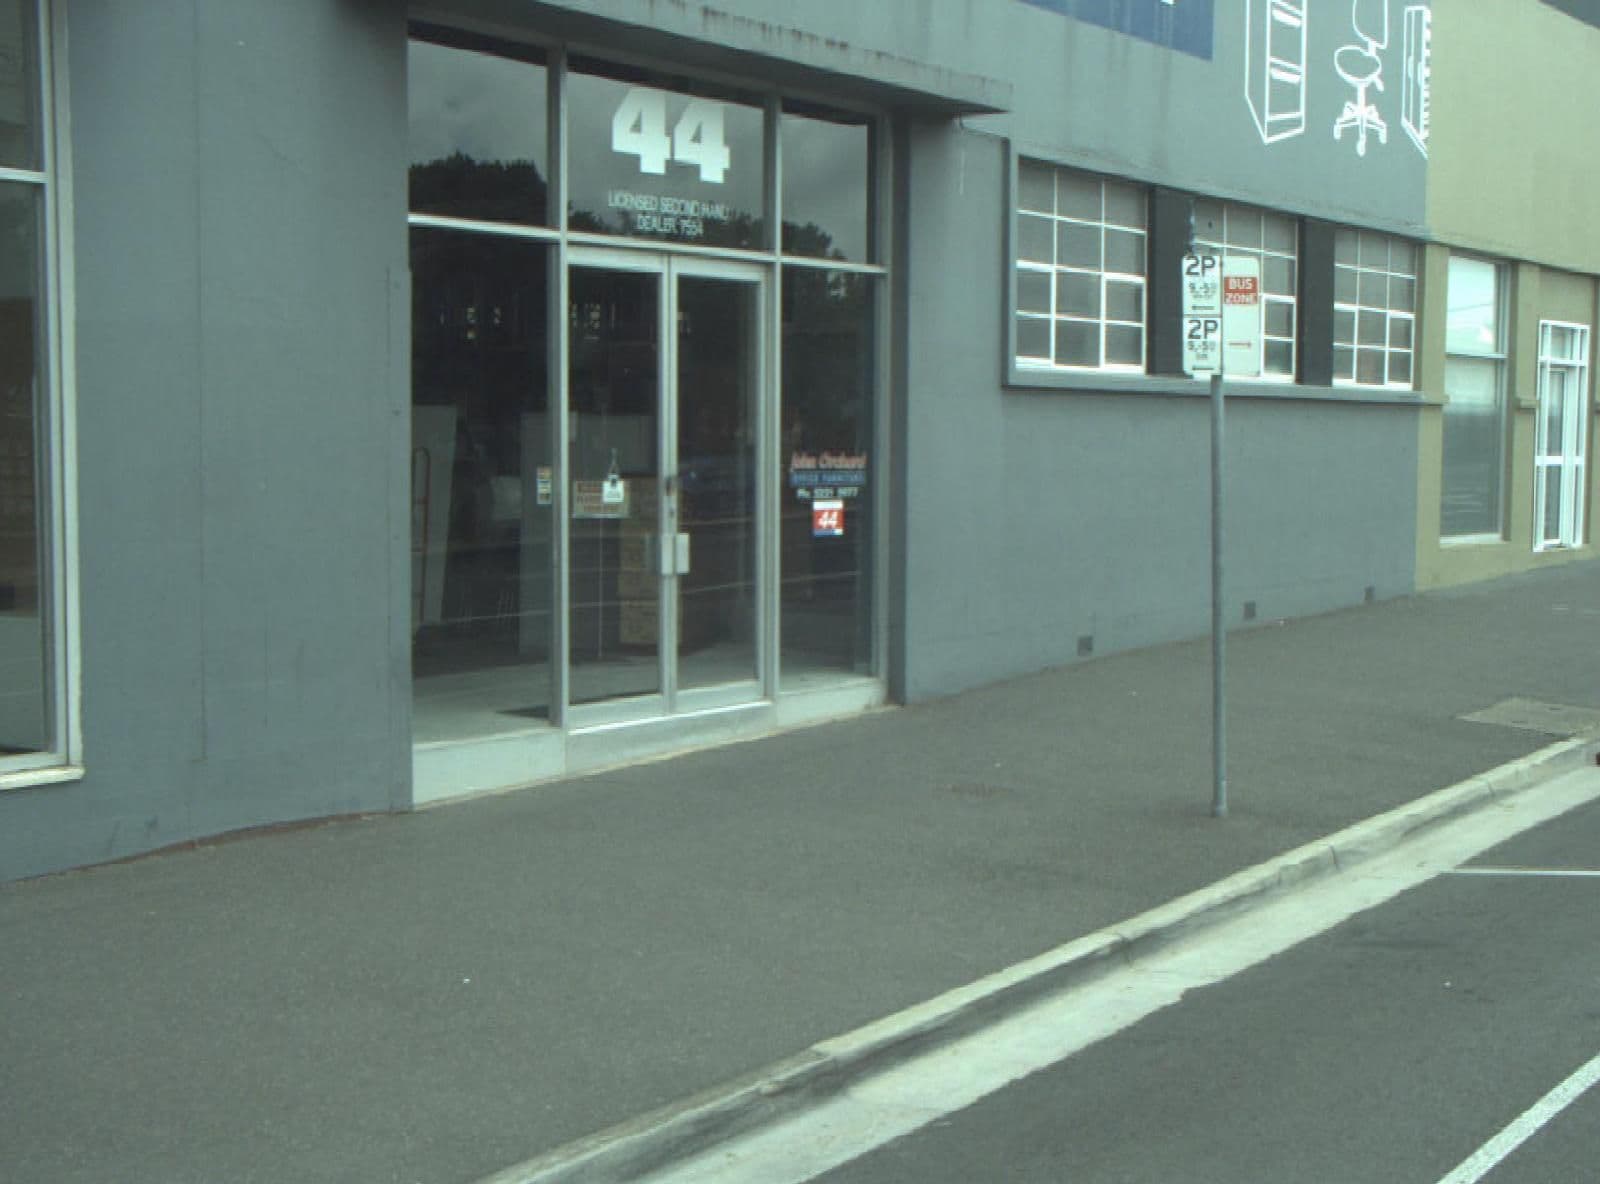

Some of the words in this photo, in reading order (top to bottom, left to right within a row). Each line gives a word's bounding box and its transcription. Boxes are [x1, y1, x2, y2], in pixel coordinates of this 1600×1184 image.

[611, 87, 731, 184] 44
[1186, 256, 1215, 276] 2P
[1229, 279, 1253, 289] BUS
[1226, 293, 1256, 304] ZONE
[1188, 320, 1218, 339] 2P
[819, 511, 838, 528] 44
